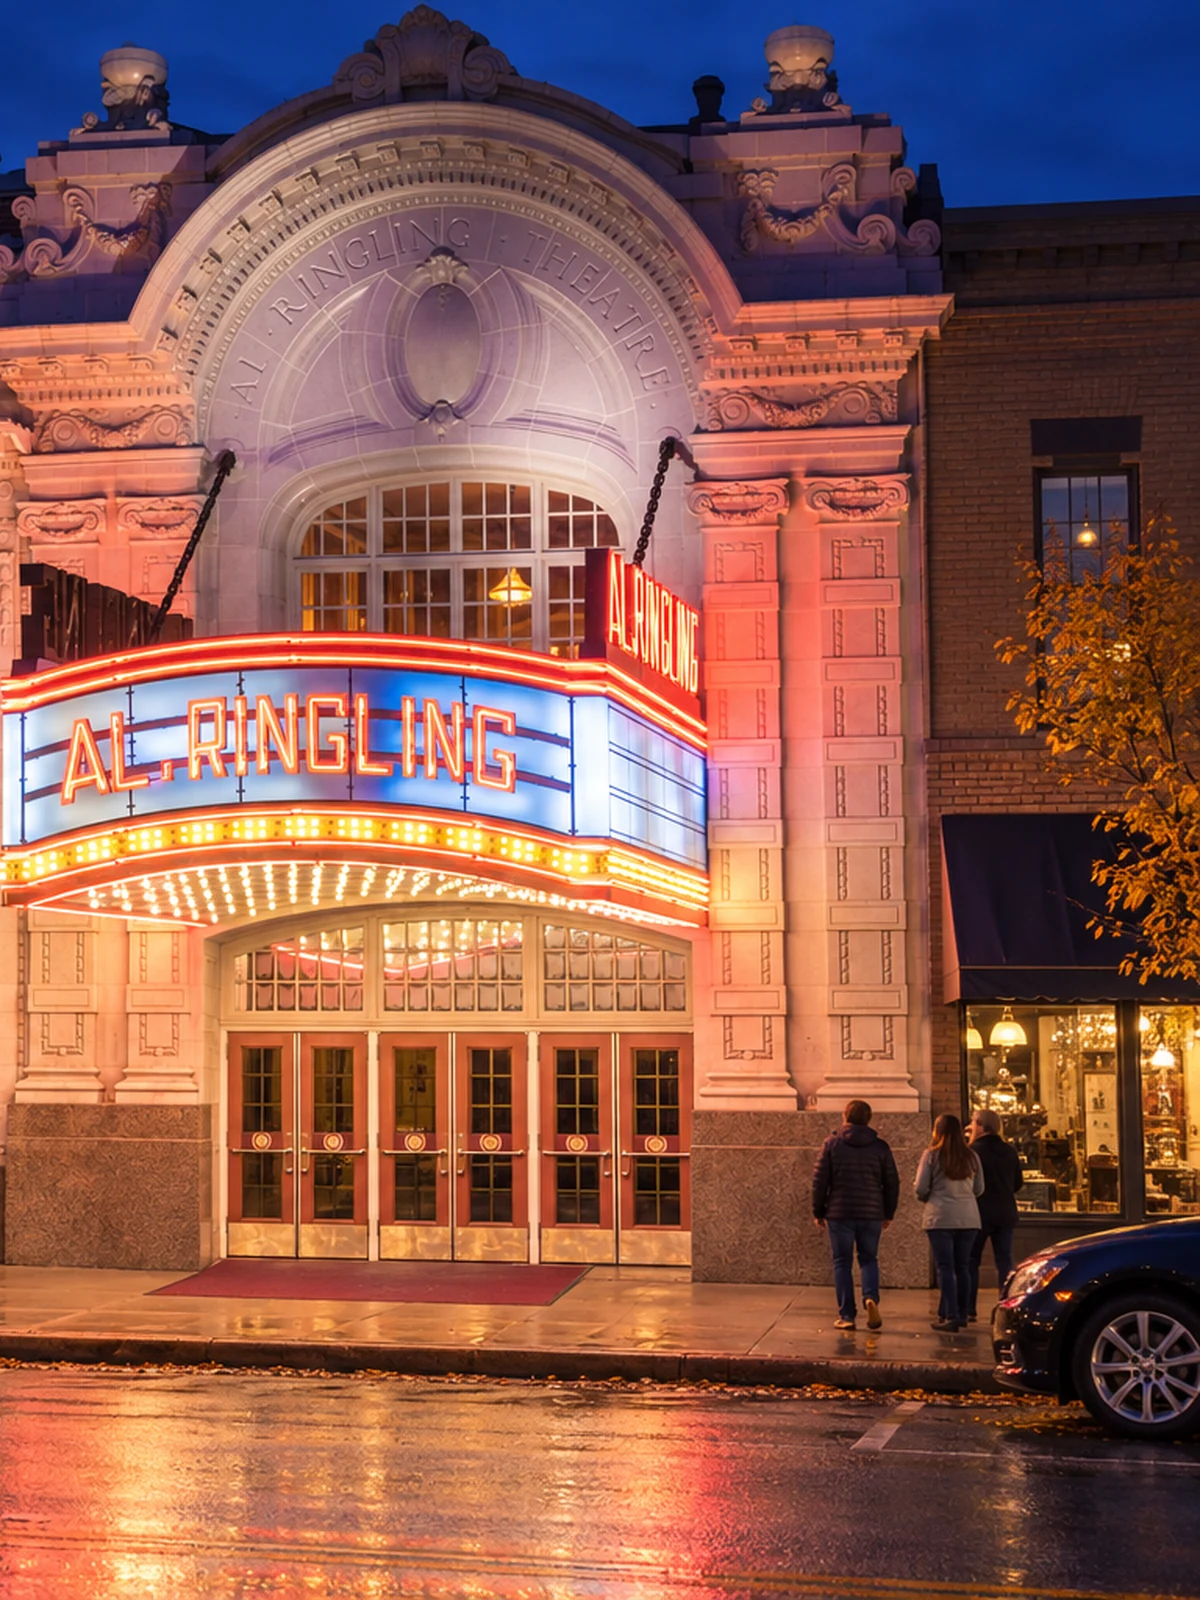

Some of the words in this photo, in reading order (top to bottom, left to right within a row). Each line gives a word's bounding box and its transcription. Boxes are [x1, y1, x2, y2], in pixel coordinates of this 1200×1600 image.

[229, 356, 269, 405] AL
[268, 215, 472, 326] RINGLING
[520, 228, 674, 392] THEATRE
[59, 710, 174, 806] AL.
[186, 691, 517, 795] RINGLING
